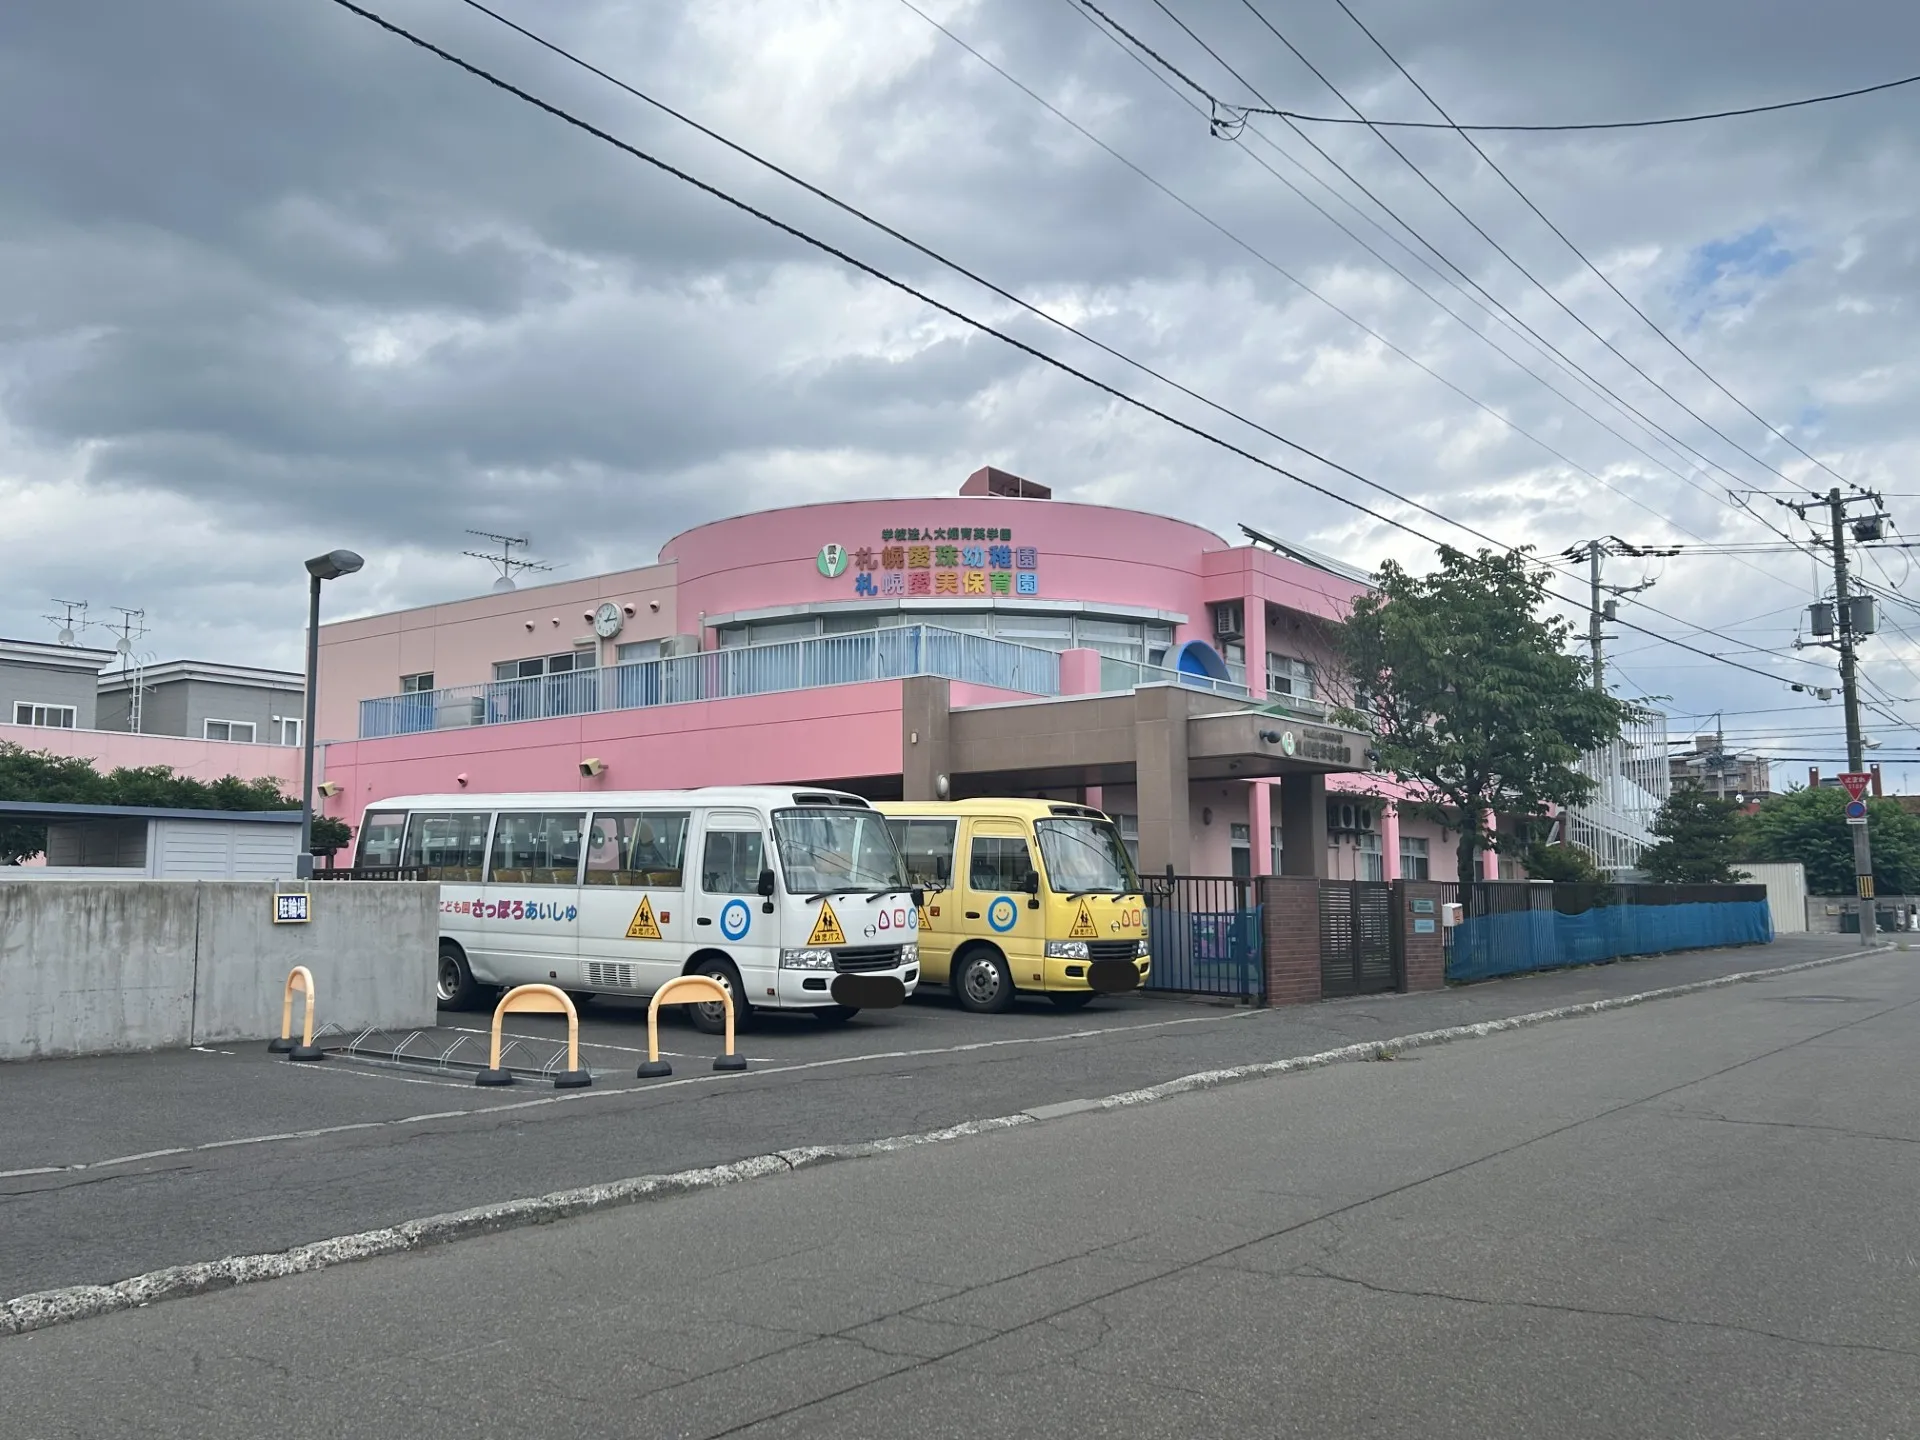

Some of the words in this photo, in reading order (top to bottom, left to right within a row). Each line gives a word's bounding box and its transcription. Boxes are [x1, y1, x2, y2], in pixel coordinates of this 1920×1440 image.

[855, 545, 1038, 571] 札幌愛珠幼稚園
[855, 571, 1038, 597] 札幌愛実保育園
[278, 897, 307, 919] 駐輪場
[814, 932, 841, 942] 幼児バス
